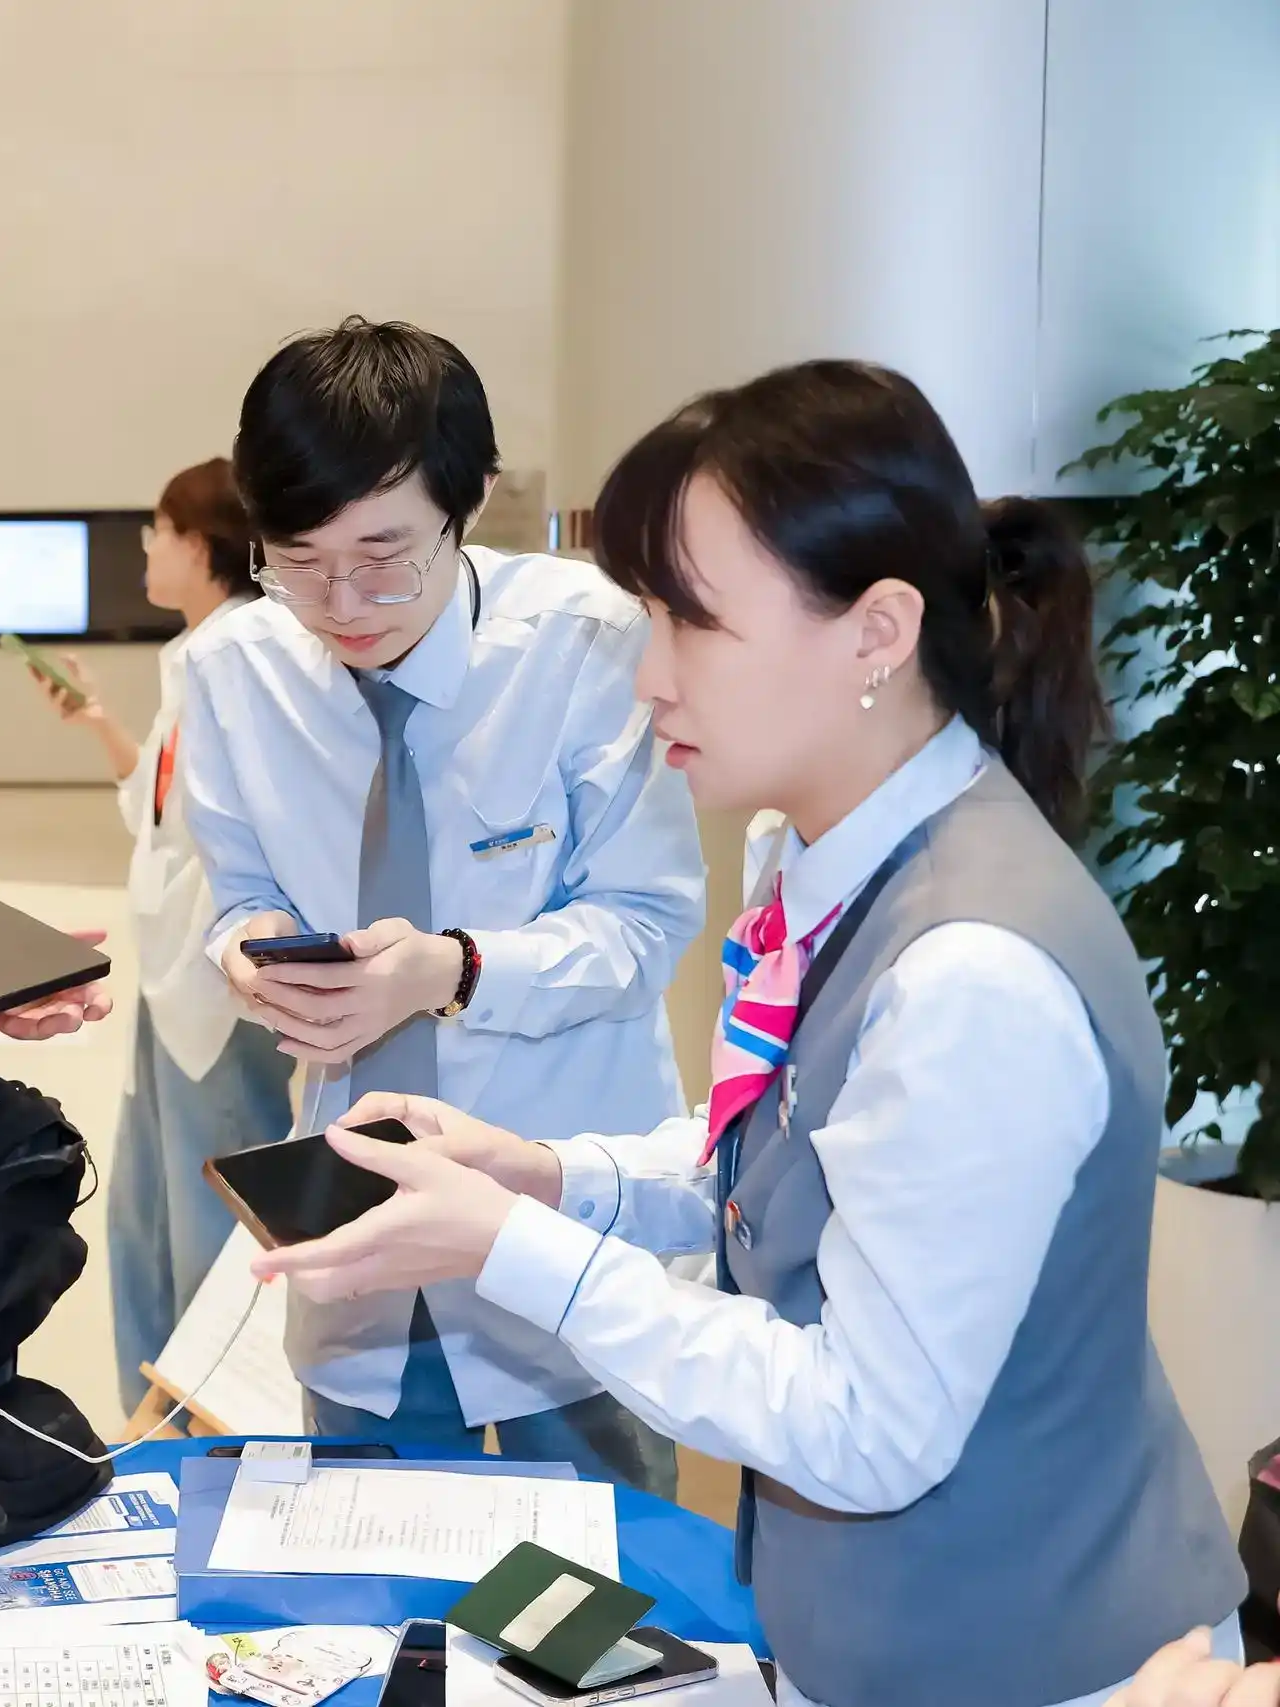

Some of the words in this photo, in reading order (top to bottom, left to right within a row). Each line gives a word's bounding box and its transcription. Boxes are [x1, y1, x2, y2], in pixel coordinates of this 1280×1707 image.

[39, 1569, 64, 1601] SHANGHAI
[57, 1577, 71, 1590] AND
[63, 1590, 78, 1601] SEE
